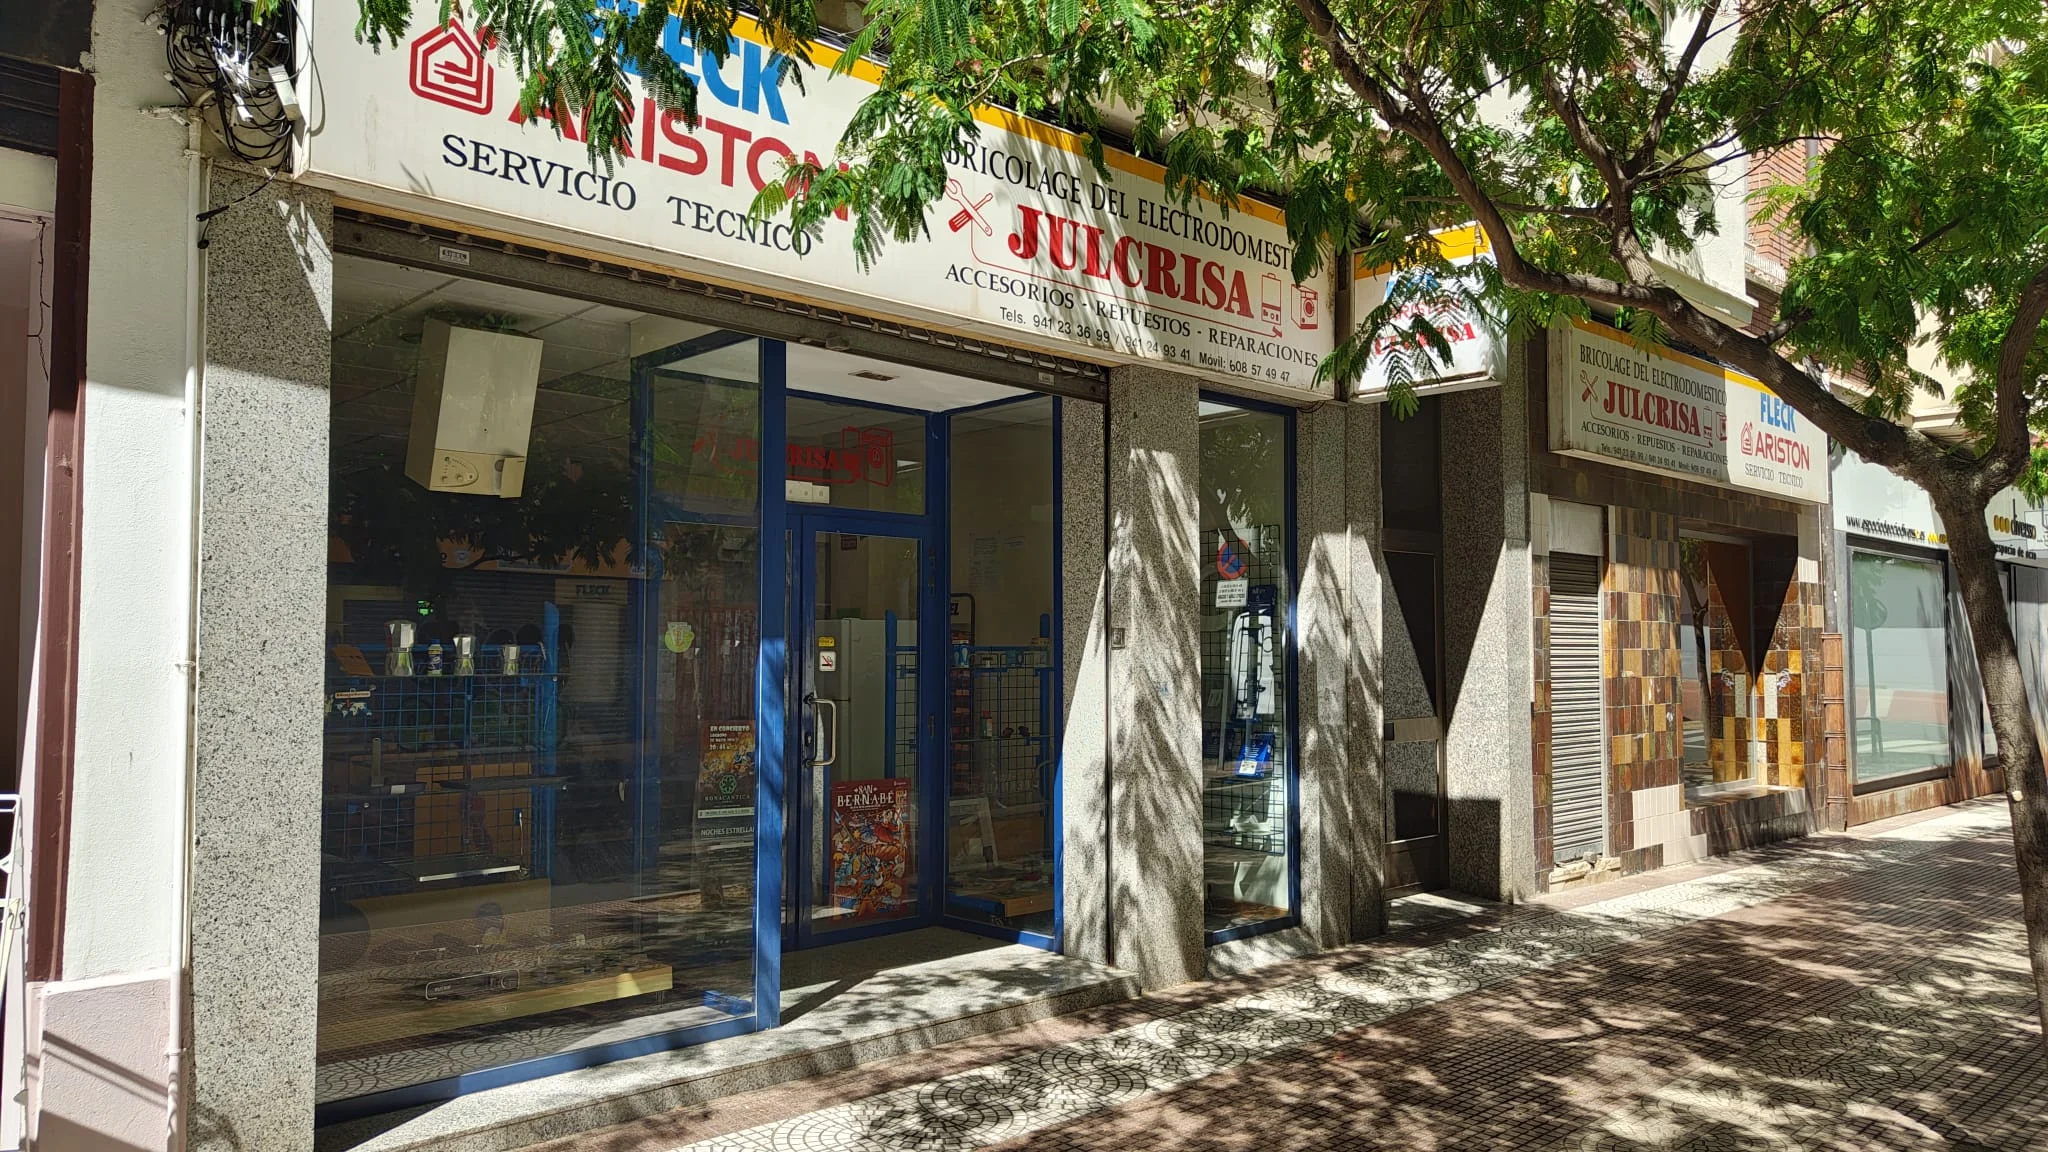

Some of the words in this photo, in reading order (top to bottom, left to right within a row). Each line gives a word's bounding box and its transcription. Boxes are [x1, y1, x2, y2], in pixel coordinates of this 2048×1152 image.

[442, 134, 637, 211] SERVICIO
[945, 139, 1081, 204] BRICOLAGE
[1090, 182, 1129, 220] DEL
[667, 196, 812, 256] TECNICO
[1008, 204, 1254, 319] JULCRISA
[945, 264, 1075, 309] ACCESORIOS
[1096, 300, 1191, 337] REPUESTOS
[1208, 328, 1318, 368] REPARACIONES
[1000, 307, 1026, 324] Tels.
[1033, 315, 1052, 330] 941
[1058, 321, 1071, 334] 23
[1077, 324, 1091, 338] 36
[1096, 327, 1110, 342] 99
[1125, 336, 1142, 350] 941
[1147, 340, 1159, 354] 24
[1164, 345, 1176, 358] 93
[1180, 348, 1190, 361] 41
[1200, 352, 1226, 369] Móvil:
[1229, 359, 1248, 373] 608
[1251, 364, 1262, 377] 57
[1265, 368, 1277, 380] 49
[1280, 371, 1290, 382] 47
[1580, 344, 1630, 376] BRICOLAGE
[1634, 362, 1649, 382] DEL
[1603, 380, 1701, 437] JULCRISA
[1760, 391, 1796, 433] FLECK
[1581, 421, 1630, 441] ACCESORIOS
[1637, 434, 1675, 452] REPUESTOS
[1755, 431, 1810, 471] ARISTON
[1745, 463, 1774, 481] SERVICIO
[1778, 472, 1803, 488] TECNICO
[837, 790, 894, 808] BERNABÉ
[858, 784, 873, 794] SAN
